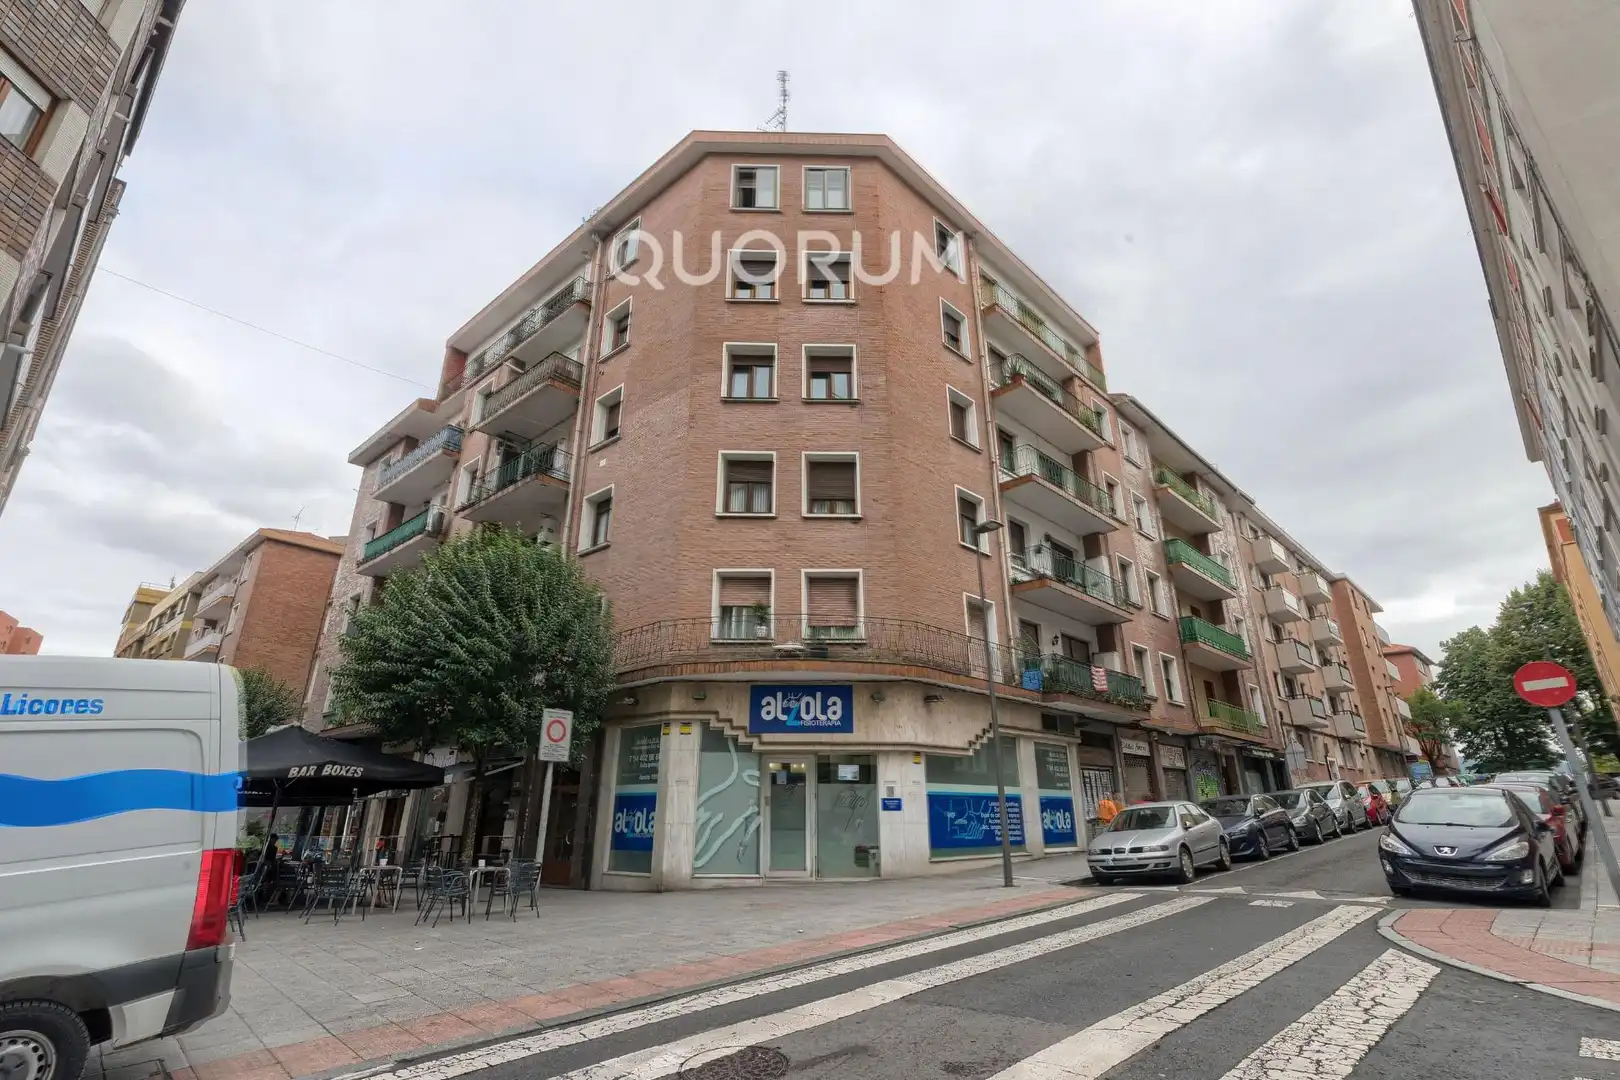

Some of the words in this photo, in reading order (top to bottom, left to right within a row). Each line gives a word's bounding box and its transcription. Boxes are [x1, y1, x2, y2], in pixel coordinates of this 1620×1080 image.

[0, 693, 104, 716] Licores
[760, 691, 843, 726] alzola
[800, 719, 842, 727] FISIOTERAPIA
[288, 765, 317, 778] BAR
[322, 764, 364, 778] BOXES
